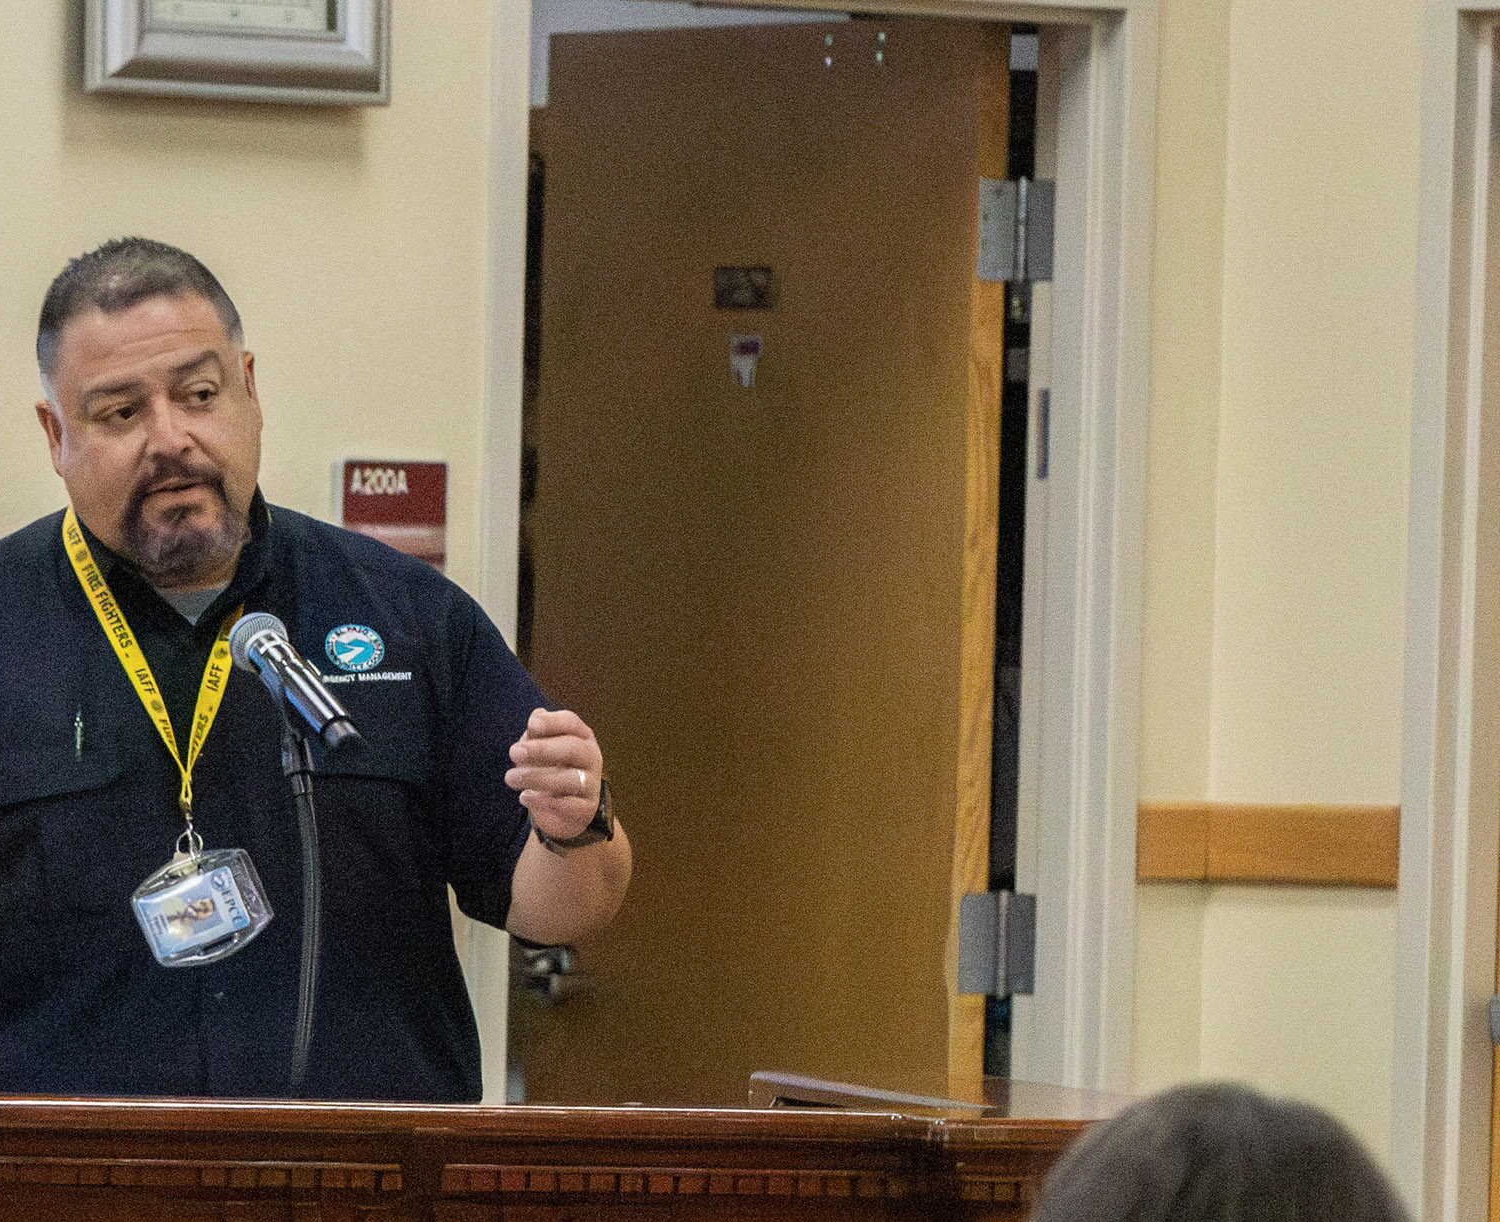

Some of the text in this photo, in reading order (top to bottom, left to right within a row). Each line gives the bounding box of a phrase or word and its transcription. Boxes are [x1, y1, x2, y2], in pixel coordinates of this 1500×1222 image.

[350, 468, 409, 495] A200A
[95, 587, 133, 650] FIGHTERS
[134, 667, 157, 695] IAFF
[206, 663, 224, 692] IAFF
